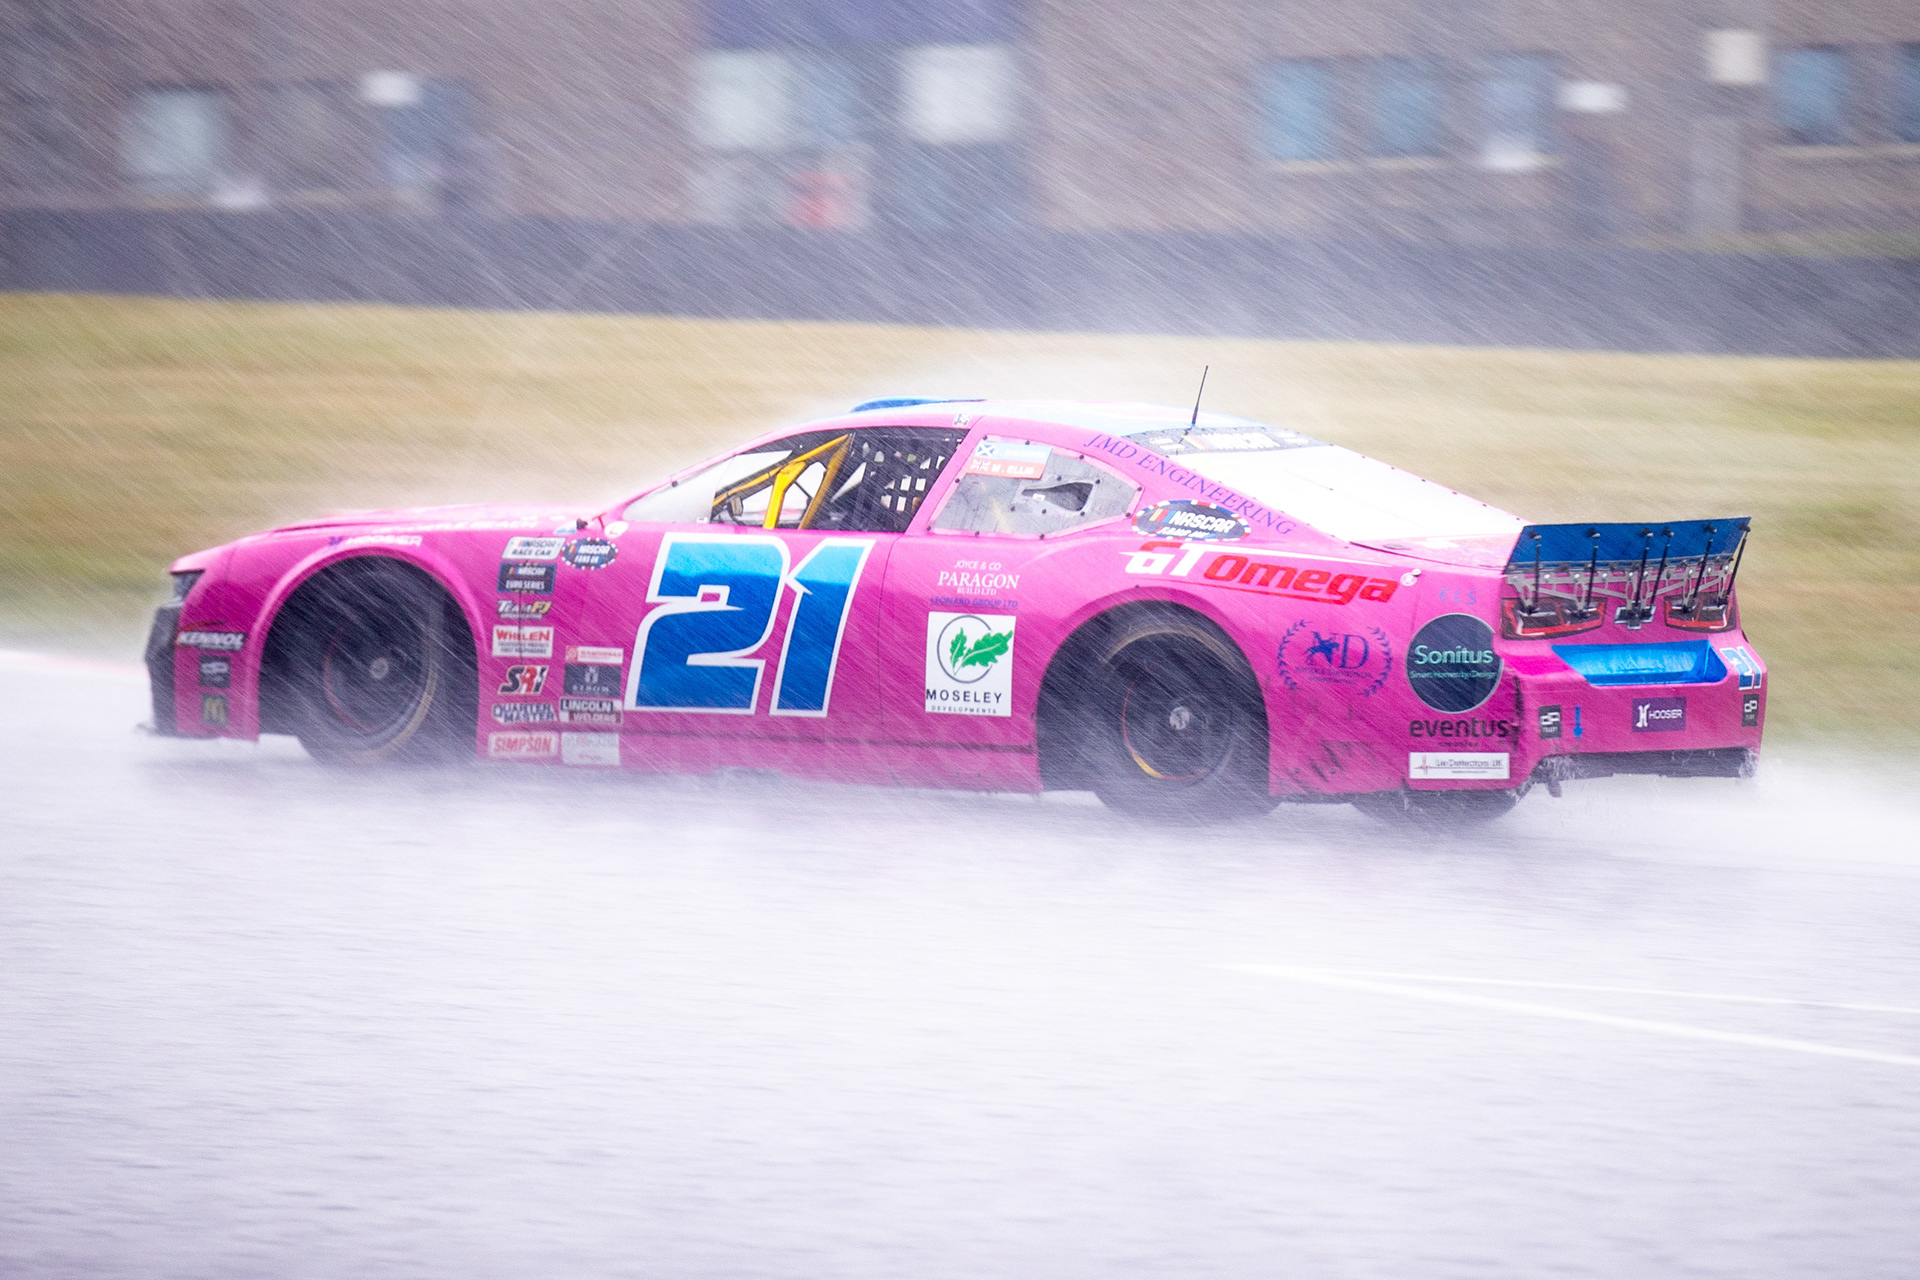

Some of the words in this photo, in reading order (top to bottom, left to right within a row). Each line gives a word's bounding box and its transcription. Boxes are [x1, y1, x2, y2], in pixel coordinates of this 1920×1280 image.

[1007, 465, 1035, 475] ELLIS
[1083, 434, 1138, 459] JMD
[1136, 453, 1297, 535] ENGINEERING
[1168, 510, 1237, 533] NASCAR
[511, 548, 533, 556] RACE
[578, 544, 611, 556] NASCAR
[574, 555, 591, 564] FANS
[954, 559, 978, 571] JOYCE
[980, 562, 987, 571] &
[988, 562, 1002, 572] CO
[516, 566, 547, 576] NASCAR
[505, 579, 523, 589] EURO
[523, 580, 546, 590] SERIES
[937, 571, 1020, 589] PARAGON
[1203, 554, 1399, 606] Omega
[956, 586, 981, 595] BUILD
[981, 588, 997, 596] LTD
[972, 597, 1002, 608] GROUP
[1002, 600, 1019, 609] LTD
[624, 532, 877, 718] 21
[1414, 645, 1494, 665] Sonitus
[926, 689, 1003, 704] MOSELEY
[562, 700, 612, 712] LINCOLN
[931, 705, 998, 715] DEVELOPMENTS
[503, 712, 555, 723] MASTER
[1648, 708, 1684, 720] HOOSIER
[1409, 717, 1510, 738] eventus
[493, 737, 552, 753] SIMPSON
